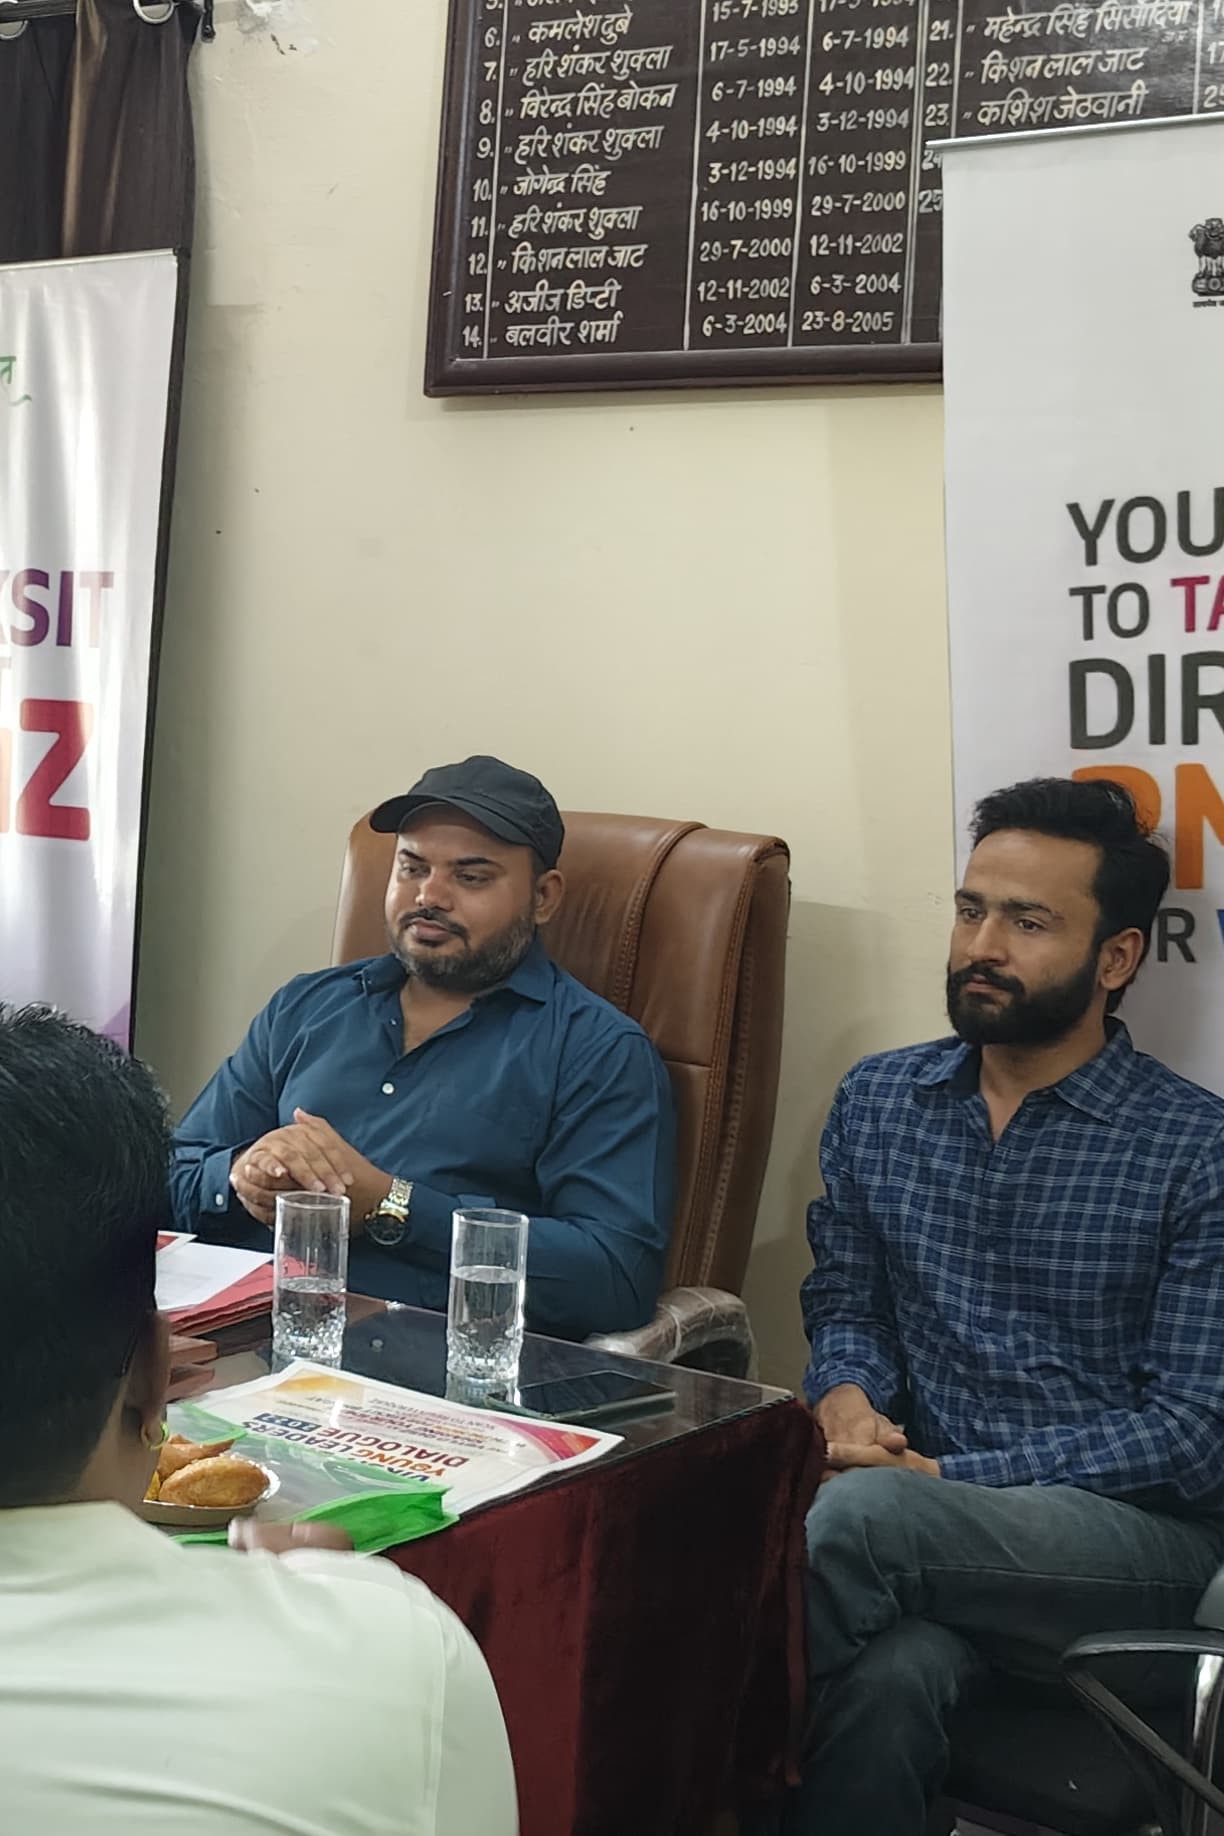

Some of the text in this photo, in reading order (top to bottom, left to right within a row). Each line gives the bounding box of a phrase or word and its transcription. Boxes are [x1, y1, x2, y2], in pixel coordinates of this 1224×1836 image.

[528, 10, 602, 43] कमलेश
[600, 5, 633, 45] दुबे
[709, 36, 800, 62] 17-5-1994
[822, 26, 910, 52] 6-7-1994
[1046, 3, 1093, 39] सिंह
[522, 48, 557, 86] हरि
[557, 44, 610, 78] शंकर
[610, 45, 674, 81] शुक्ला
[711, 76, 797, 101] 6-7-1994
[818, 66, 915, 96] 4-10-1994
[981, 49, 1046, 84] किशन
[1043, 50, 1101, 79] लाल
[1098, 47, 1149, 74] जाट
[575, 81, 618, 119] सिंह
[705, 115, 798, 143] 4-10-1994
[816, 108, 910, 131] 3-12-1994
[514, 125, 552, 165] हरि
[552, 122, 602, 158] शंकर
[602, 125, 664, 161] शुक्ला
[708, 157, 797, 184] 3-12-1994
[808, 150, 906, 176] 16-10-1999
[570, 163, 612, 195] सिंह
[701, 198, 793, 222] 16-10-1999
[810, 191, 906, 216] 29-7-2000
[507, 204, 544, 238] हरि
[543, 202, 587, 234] शंकर
[588, 205, 644, 241] शुक्ला
[699, 238, 792, 262] 29-7-2000
[809, 233, 904, 256] 12-11-2002
[565, 246, 609, 270] लाल
[607, 243, 649, 269] जाट
[697, 276, 790, 302] 12-11-2002
[810, 272, 902, 295] 6-3-2004
[504, 278, 566, 314] अजीज
[566, 277, 622, 310] डिप्टी
[702, 311, 787, 337] 6-3-2004
[801, 310, 894, 333] 23-8-2005
[577, 310, 624, 343] शर्मा
[1069, 581, 1151, 641] TO
[242, 1420, 358, 1455] LEADERS
[317, 1427, 469, 1468] DIALOGUE
[359, 1448, 447, 1477] YOUNG
